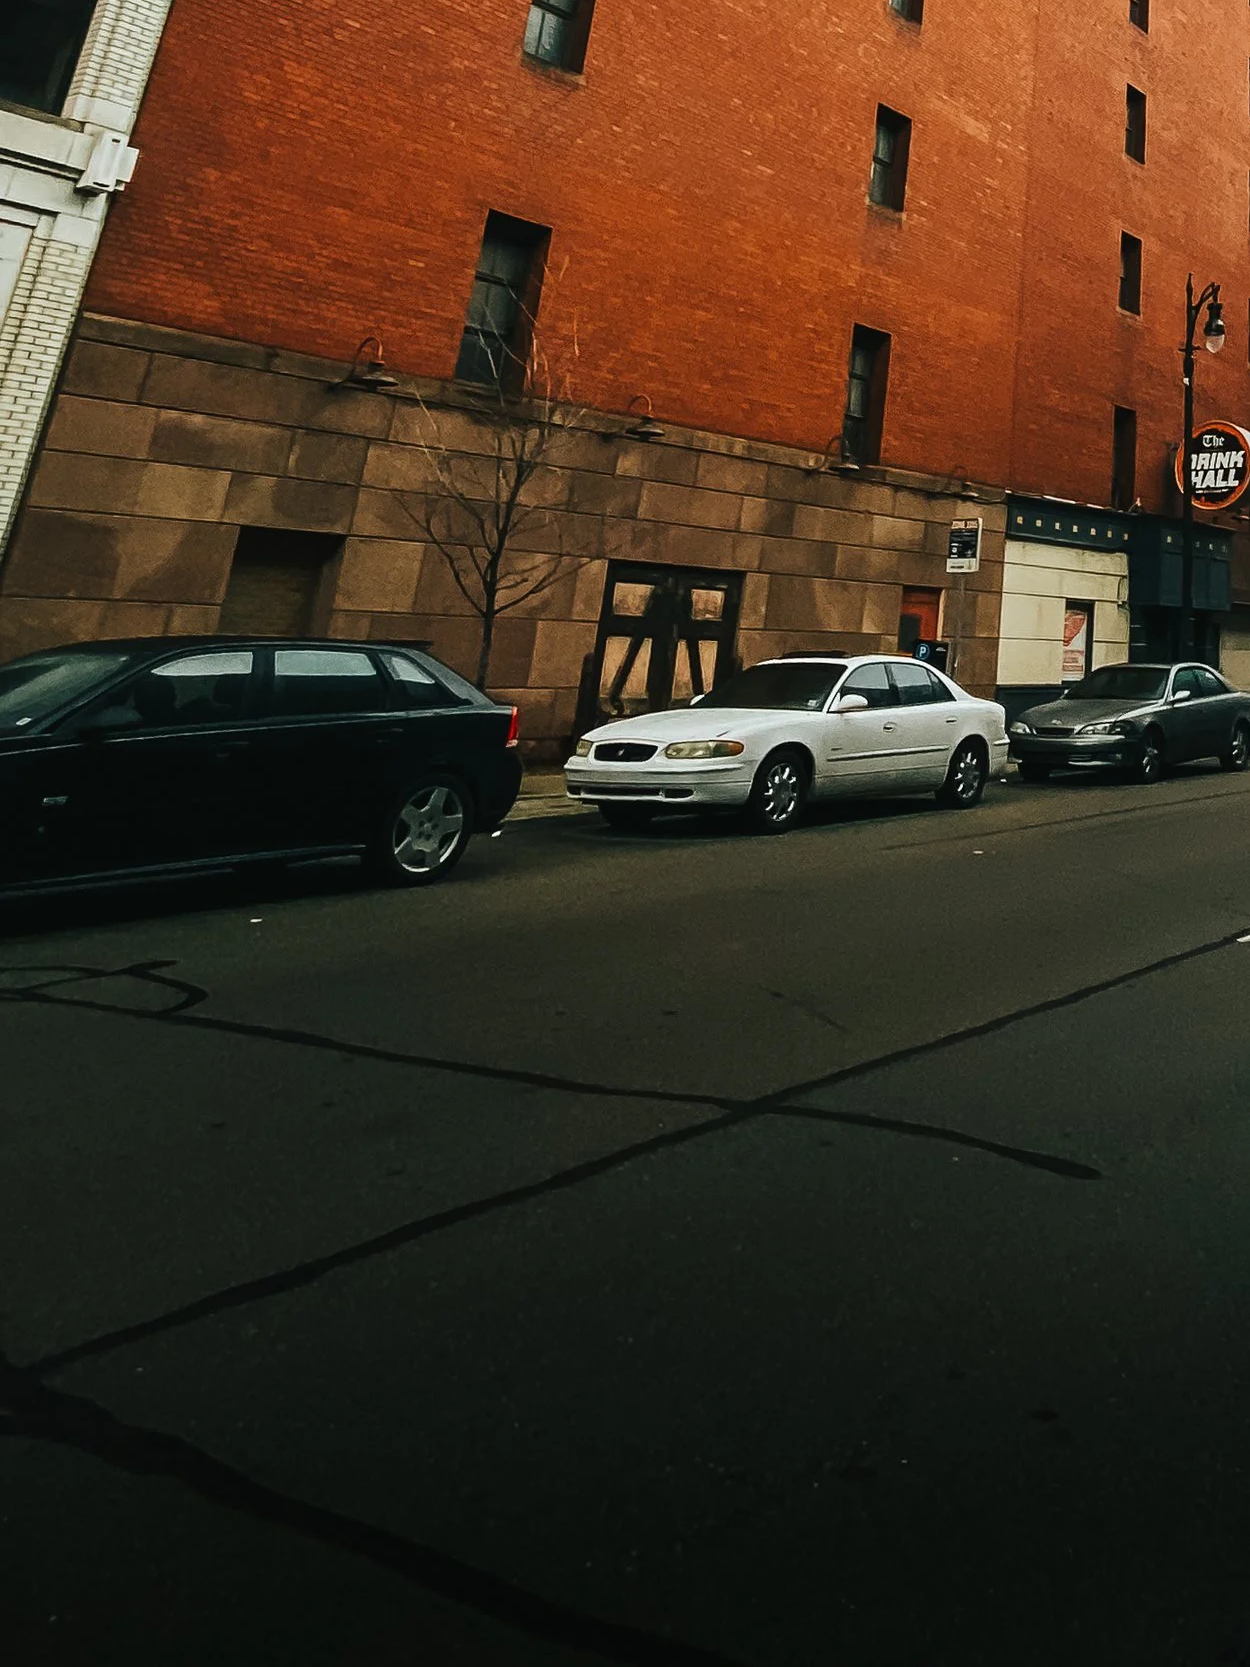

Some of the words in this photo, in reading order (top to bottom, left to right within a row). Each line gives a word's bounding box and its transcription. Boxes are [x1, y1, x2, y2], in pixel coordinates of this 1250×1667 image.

[1202, 434, 1225, 447] The
[1191, 469, 1239, 489] HALL
[919, 646, 927, 658] P
